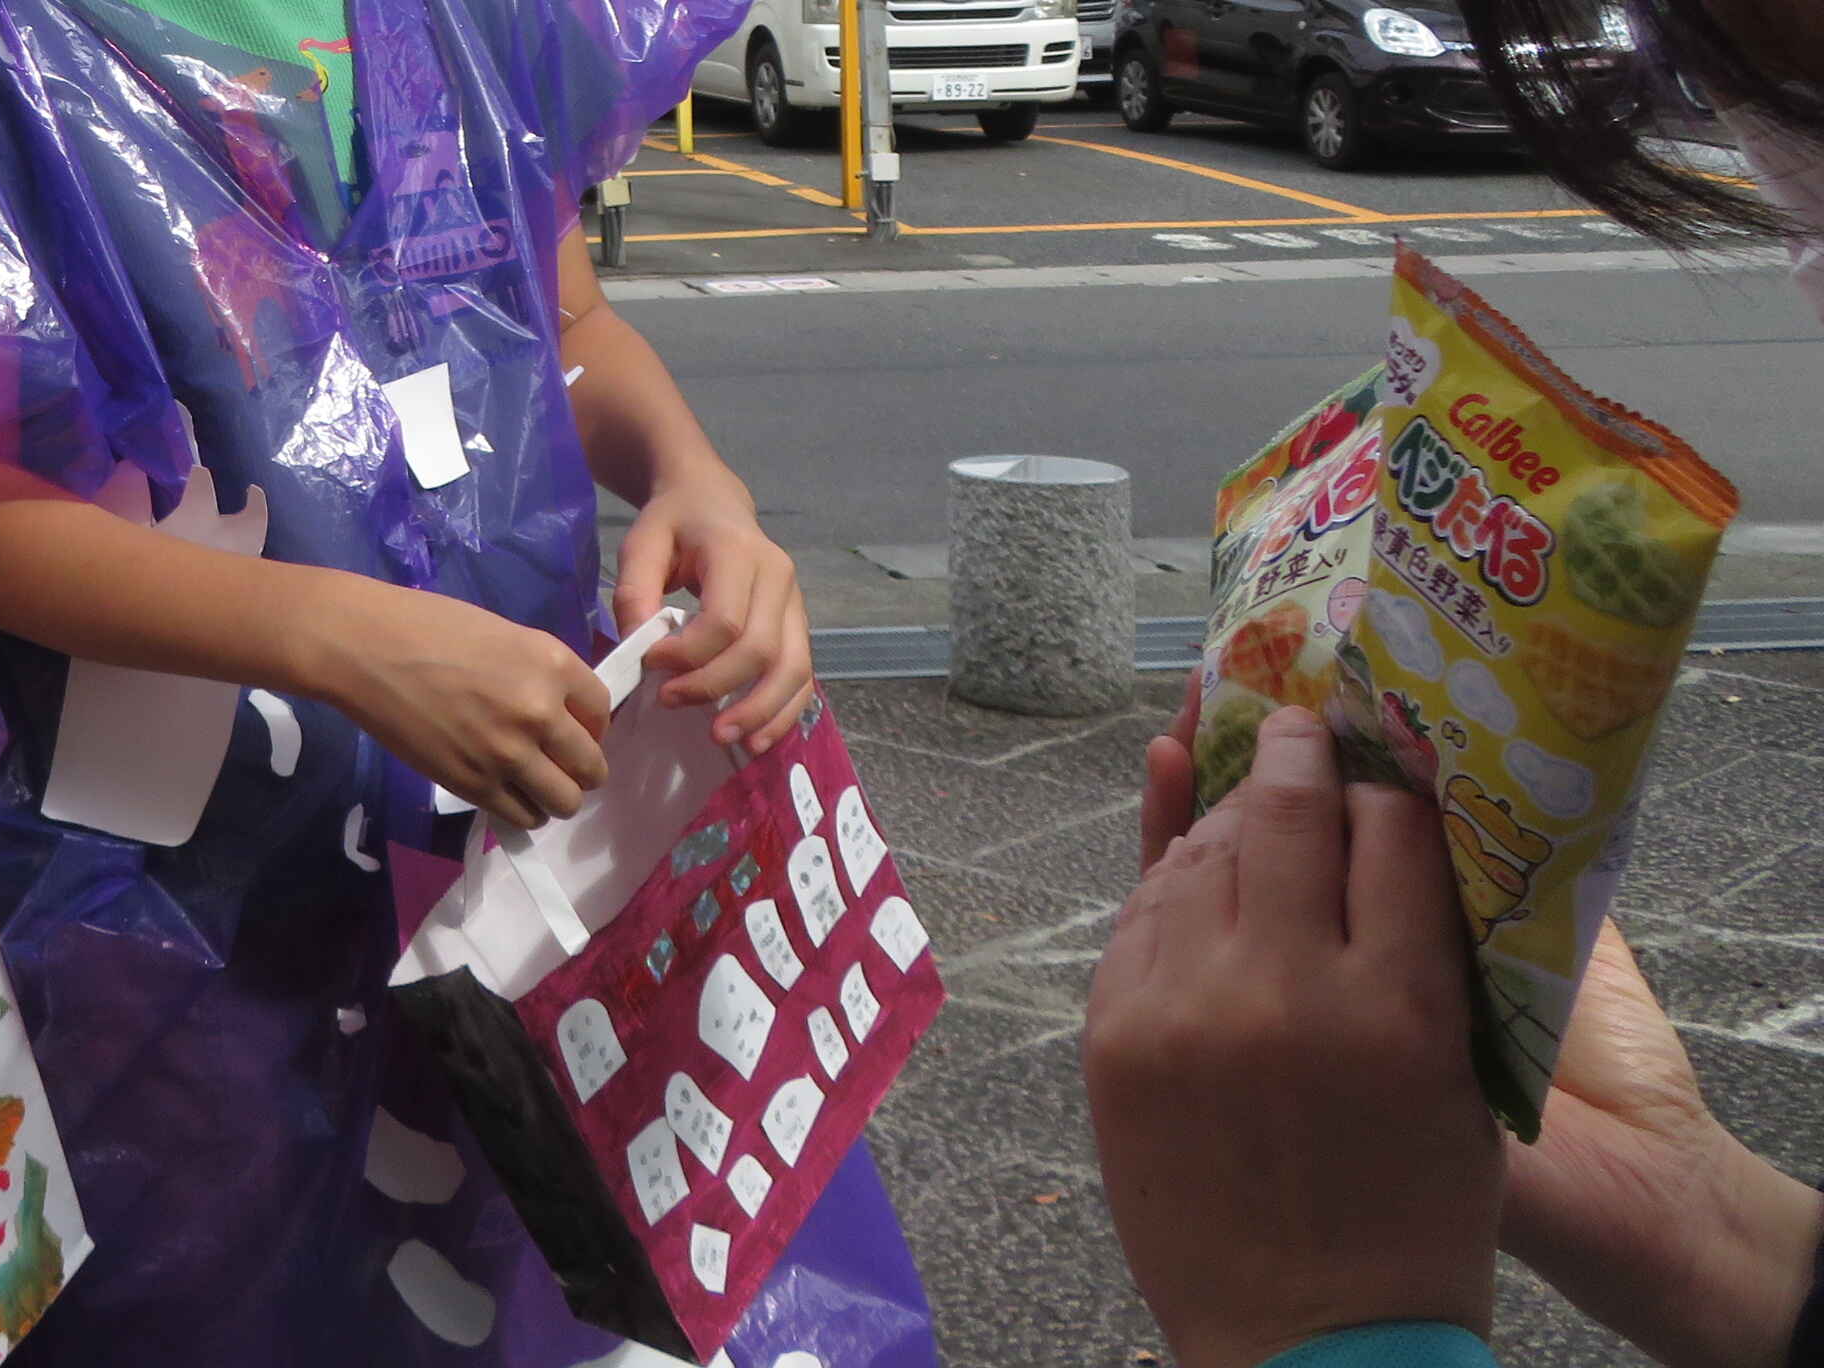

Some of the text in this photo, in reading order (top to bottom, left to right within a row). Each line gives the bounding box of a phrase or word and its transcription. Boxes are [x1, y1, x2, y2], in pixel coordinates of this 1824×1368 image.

[1389, 419, 1552, 600] ベジたべる
[1448, 393, 1561, 495] Calbee
